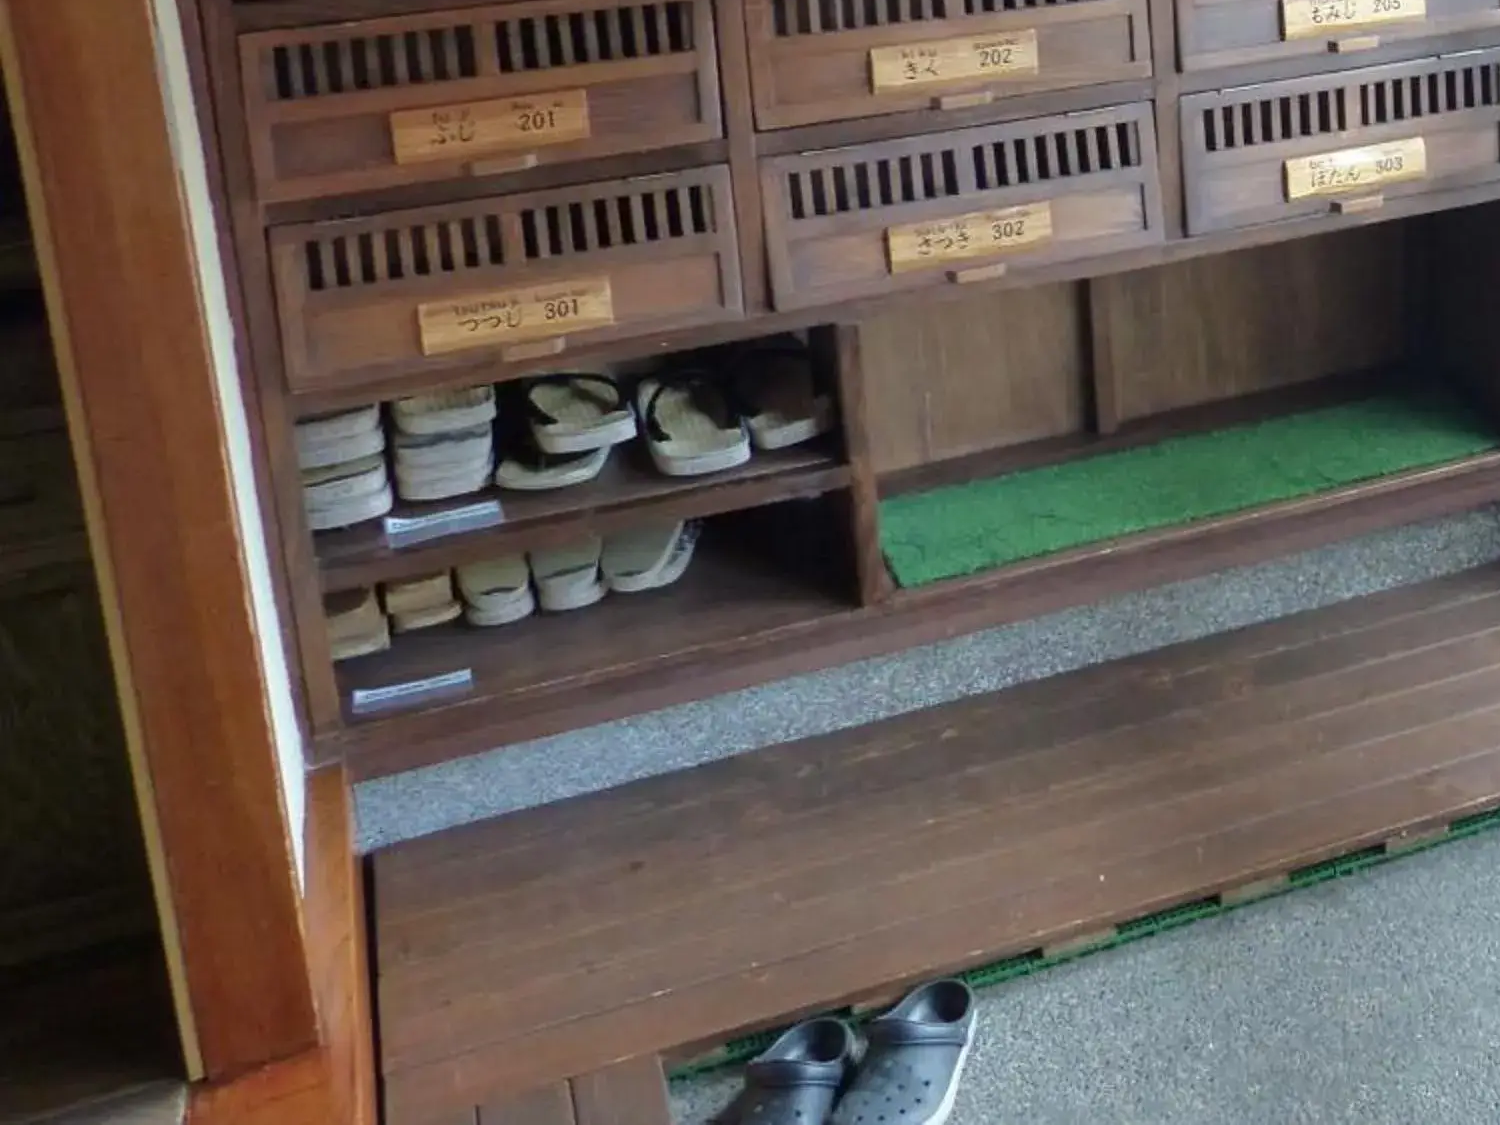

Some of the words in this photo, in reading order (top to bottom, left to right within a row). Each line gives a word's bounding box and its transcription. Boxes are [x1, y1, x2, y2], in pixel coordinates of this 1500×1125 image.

[903, 58, 940, 80] きく
[979, 47, 1013, 68] 202
[430, 120, 476, 146] ふじ
[517, 110, 556, 132] 201
[916, 229, 971, 256] さつき
[991, 220, 1025, 241] 302
[457, 306, 524, 333] つつじ
[543, 298, 579, 321] 301
